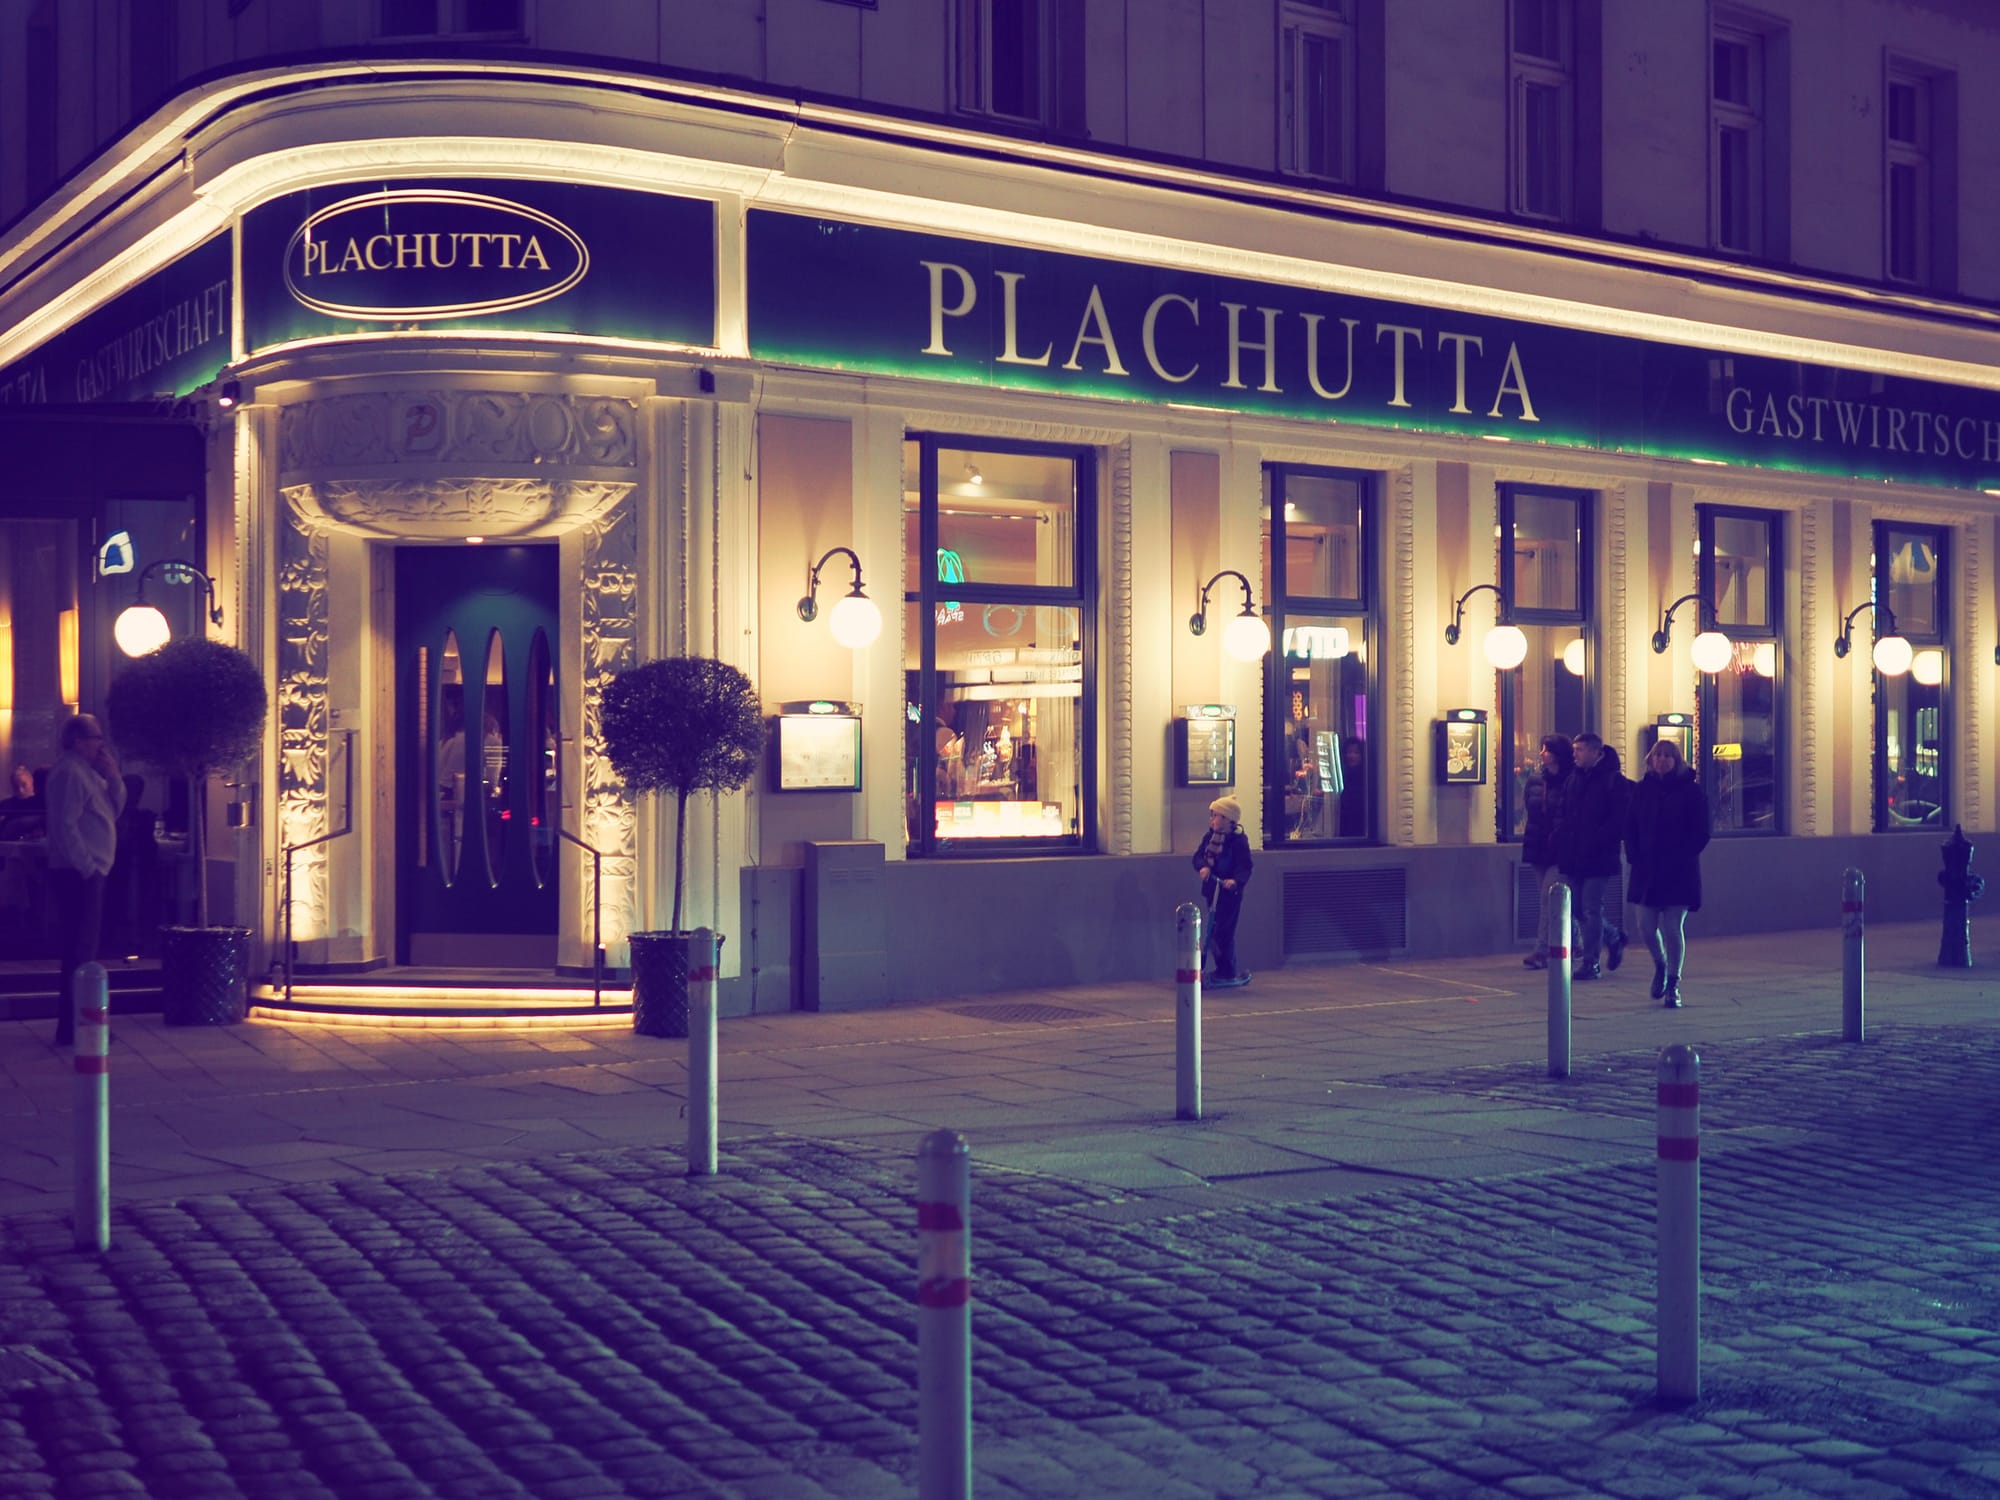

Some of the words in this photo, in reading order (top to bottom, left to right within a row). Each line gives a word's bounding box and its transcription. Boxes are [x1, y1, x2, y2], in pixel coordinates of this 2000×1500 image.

[303, 233, 551, 277] PLACHUTTA
[76, 280, 228, 404] GASTWIRTSCHAFT
[919, 260, 1541, 422] PLACHUTTA
[1726, 387, 2000, 463] GASTWIRTSCH
